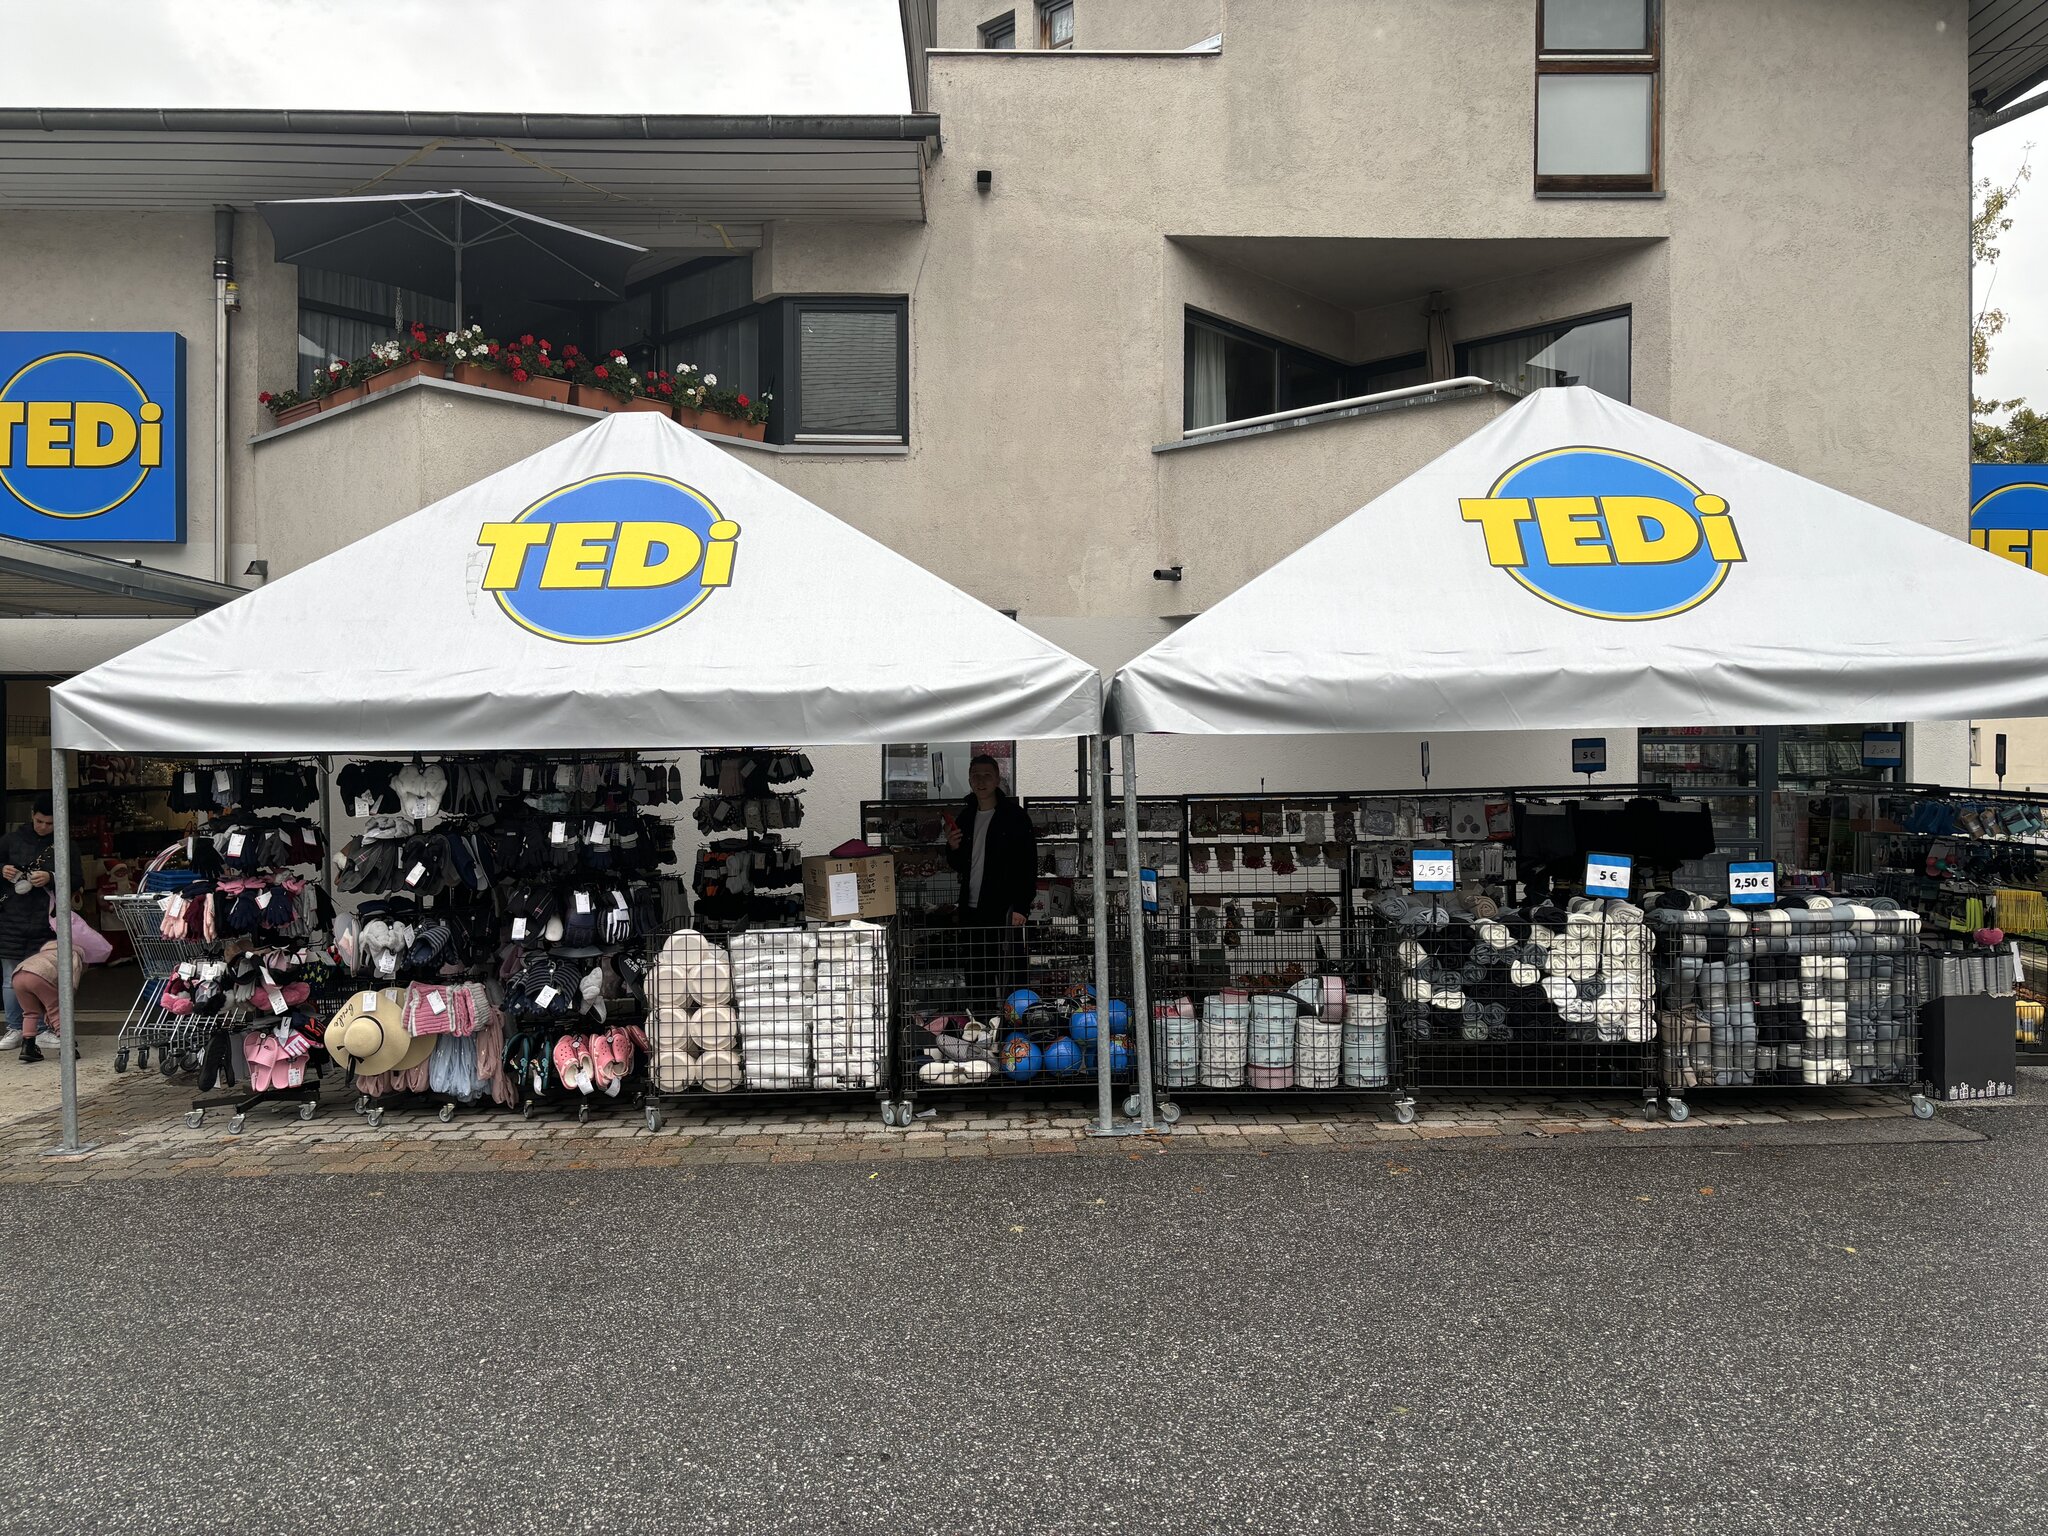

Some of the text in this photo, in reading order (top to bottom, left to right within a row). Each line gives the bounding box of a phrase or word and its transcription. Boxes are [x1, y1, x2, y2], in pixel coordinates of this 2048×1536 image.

[1458, 493, 1748, 568] TEDi
[476, 519, 742, 591] TEDi
[1599, 871, 1618, 881] 5 €
[1734, 877, 1769, 890] 2,50 €
